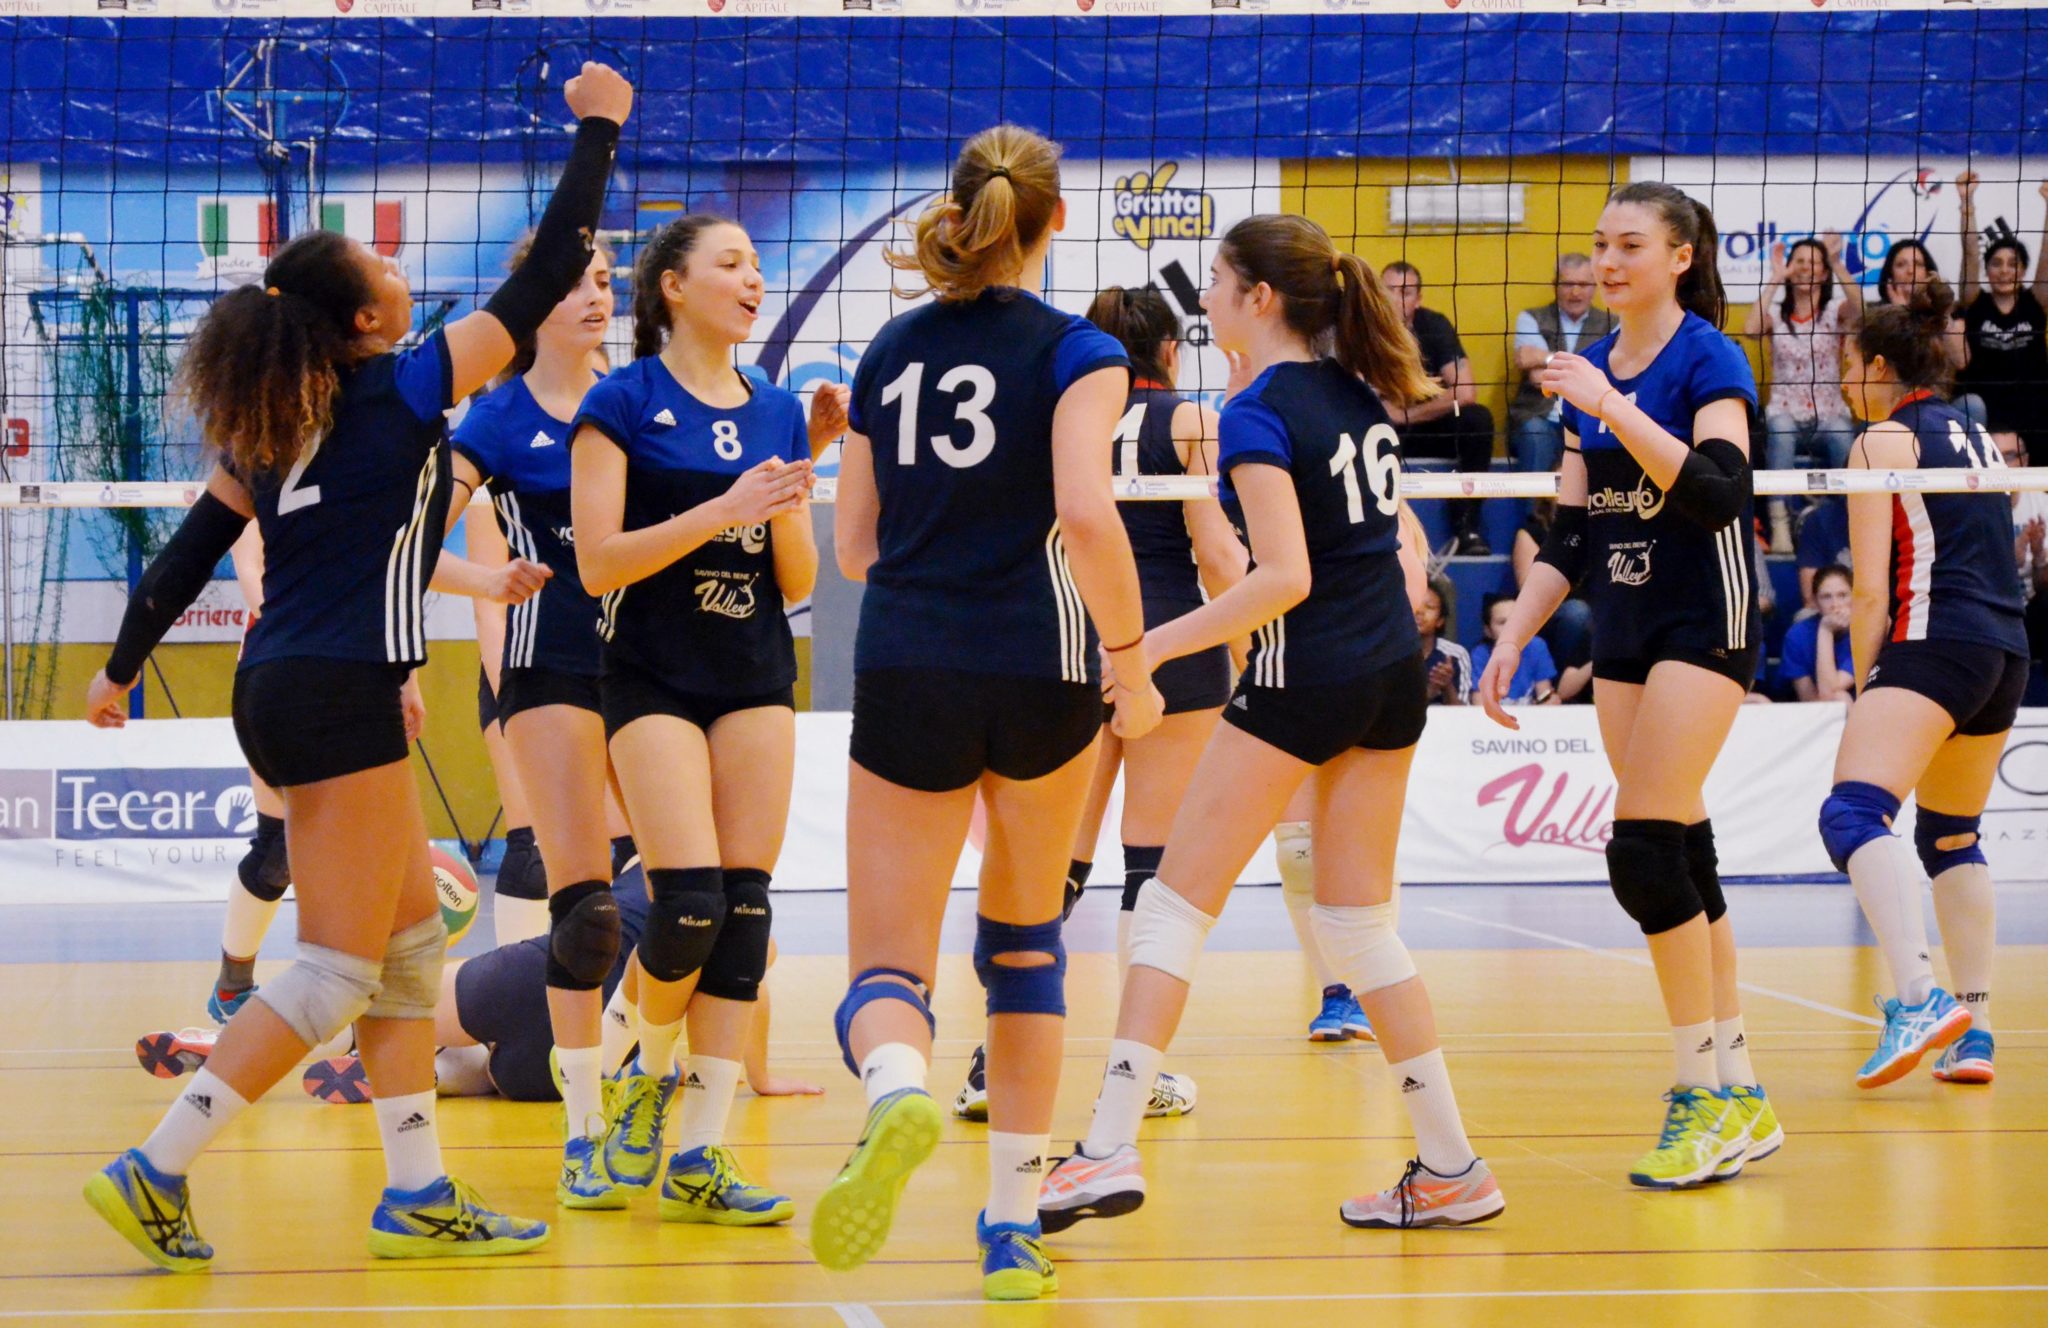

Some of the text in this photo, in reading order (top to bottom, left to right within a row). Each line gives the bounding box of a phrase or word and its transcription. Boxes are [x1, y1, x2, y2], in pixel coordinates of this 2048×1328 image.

[0, 1, 41, 12] APITALE
[363, 3, 416, 13] CAPITALE
[735, 2, 789, 13] CAPITALE
[1104, 1, 1158, 12] CAPITALE
[1117, 190, 1202, 216] Gratta
[881, 362, 997, 468] 13
[712, 420, 743, 461] 8
[277, 430, 321, 516] 2
[1329, 423, 1401, 524] 16
[175, 604, 243, 627] orriere
[1472, 739, 1597, 755] SAVINO DEL
[61, 776, 207, 831] Tecar
[1477, 762, 1614, 849] Volle
[56, 846, 228, 867] FEEL YOUR
